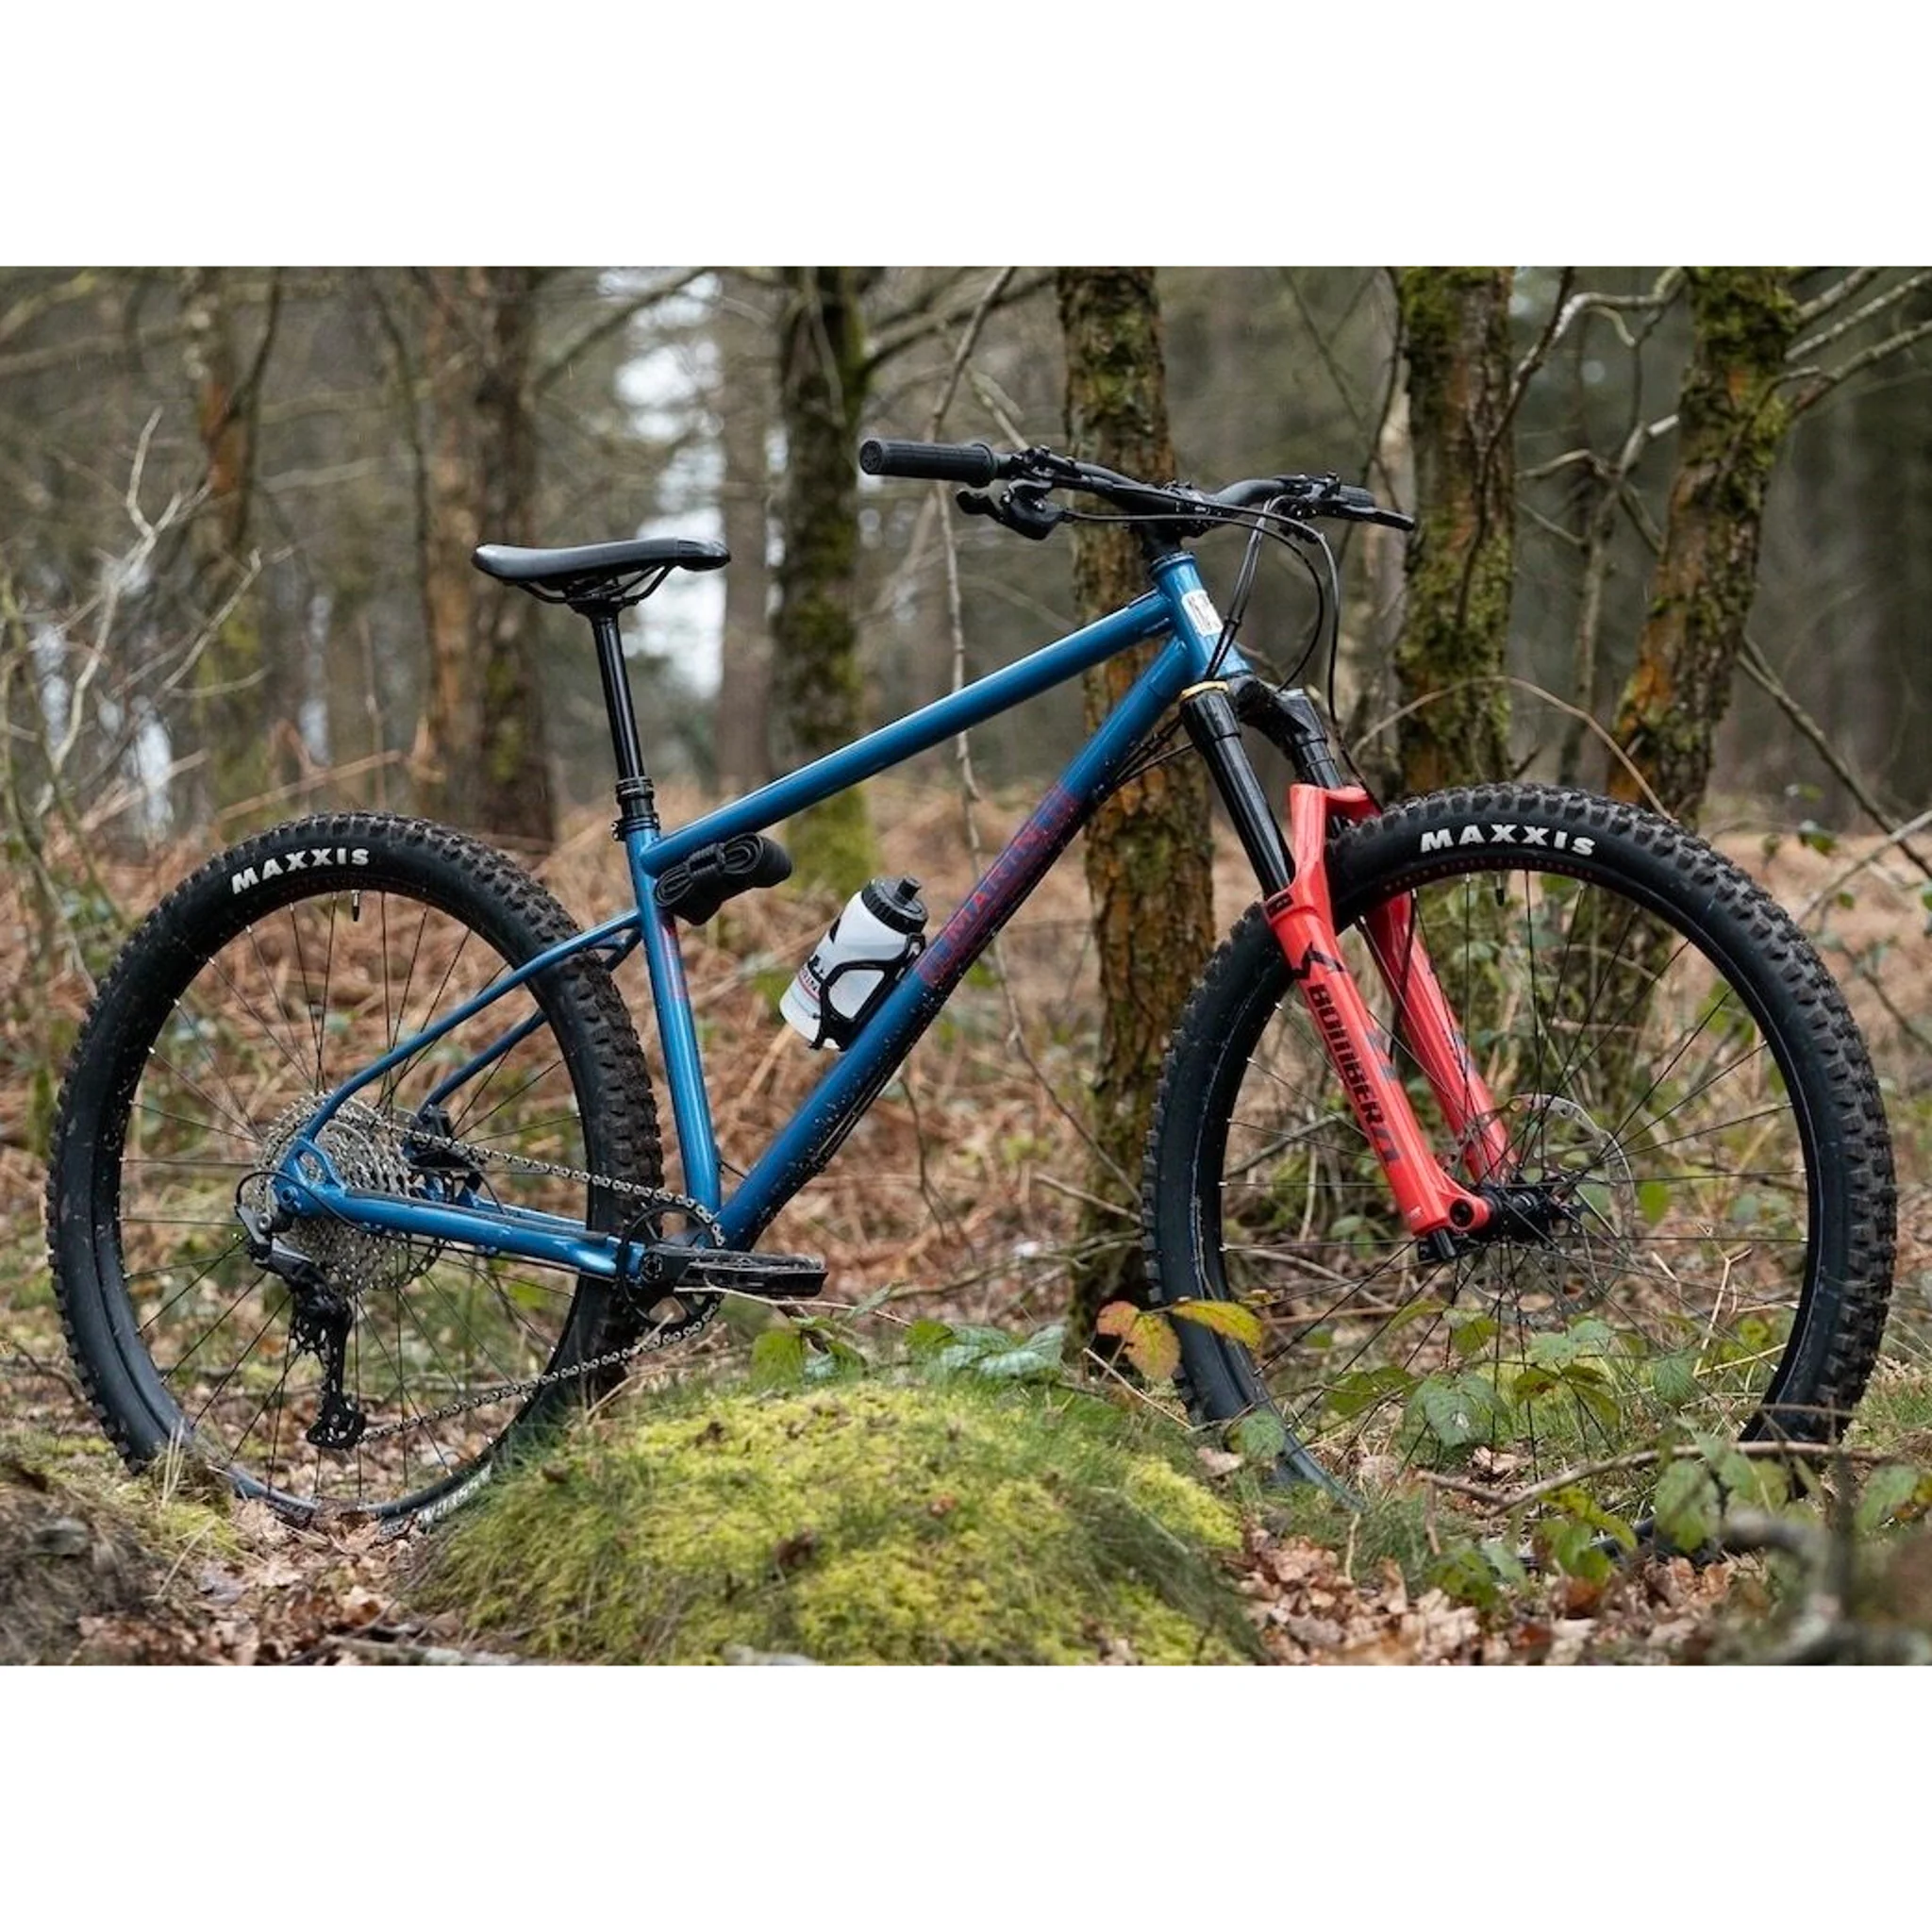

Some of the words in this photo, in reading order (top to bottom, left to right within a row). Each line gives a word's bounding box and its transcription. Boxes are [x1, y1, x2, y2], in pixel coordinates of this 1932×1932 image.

[1419, 823, 1596, 857] MAXXIS
[231, 847, 370, 894] MAXXIS
[1307, 984, 1384, 1124] BOMBER
